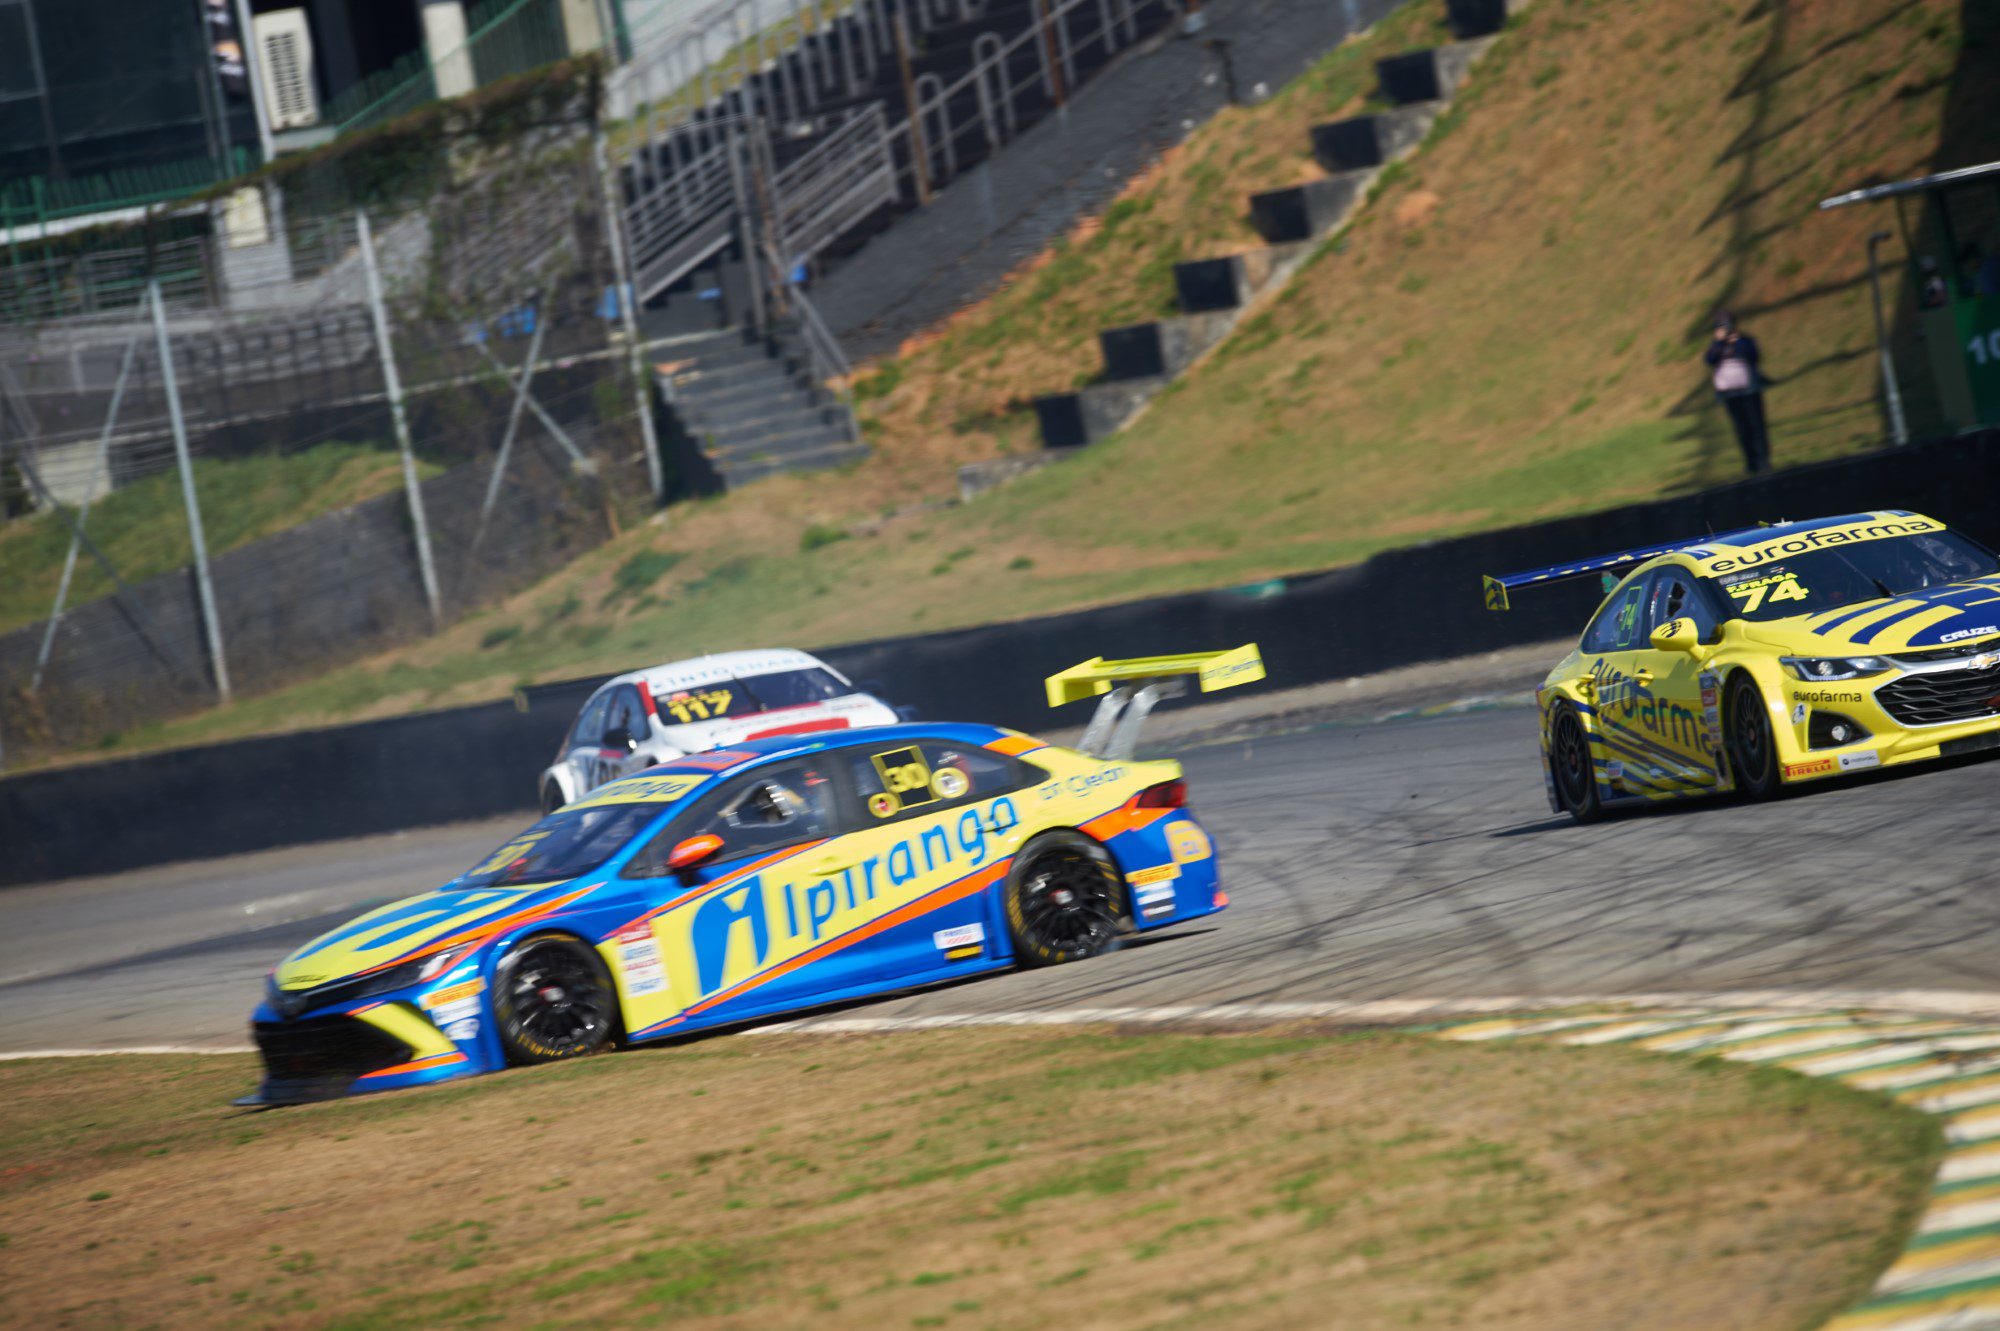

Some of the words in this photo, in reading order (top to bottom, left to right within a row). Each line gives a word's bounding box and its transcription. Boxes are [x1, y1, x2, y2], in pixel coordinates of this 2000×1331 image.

[1710, 519, 1935, 572] eurofarma
[1729, 578, 1810, 614] 74
[1939, 624, 2000, 644] CRUZE
[1793, 690, 1863, 704] eurofarma
[883, 762, 931, 794] 30
[1784, 758, 1833, 778] PIRELLI
[784, 795, 1019, 941] Ipiranga
